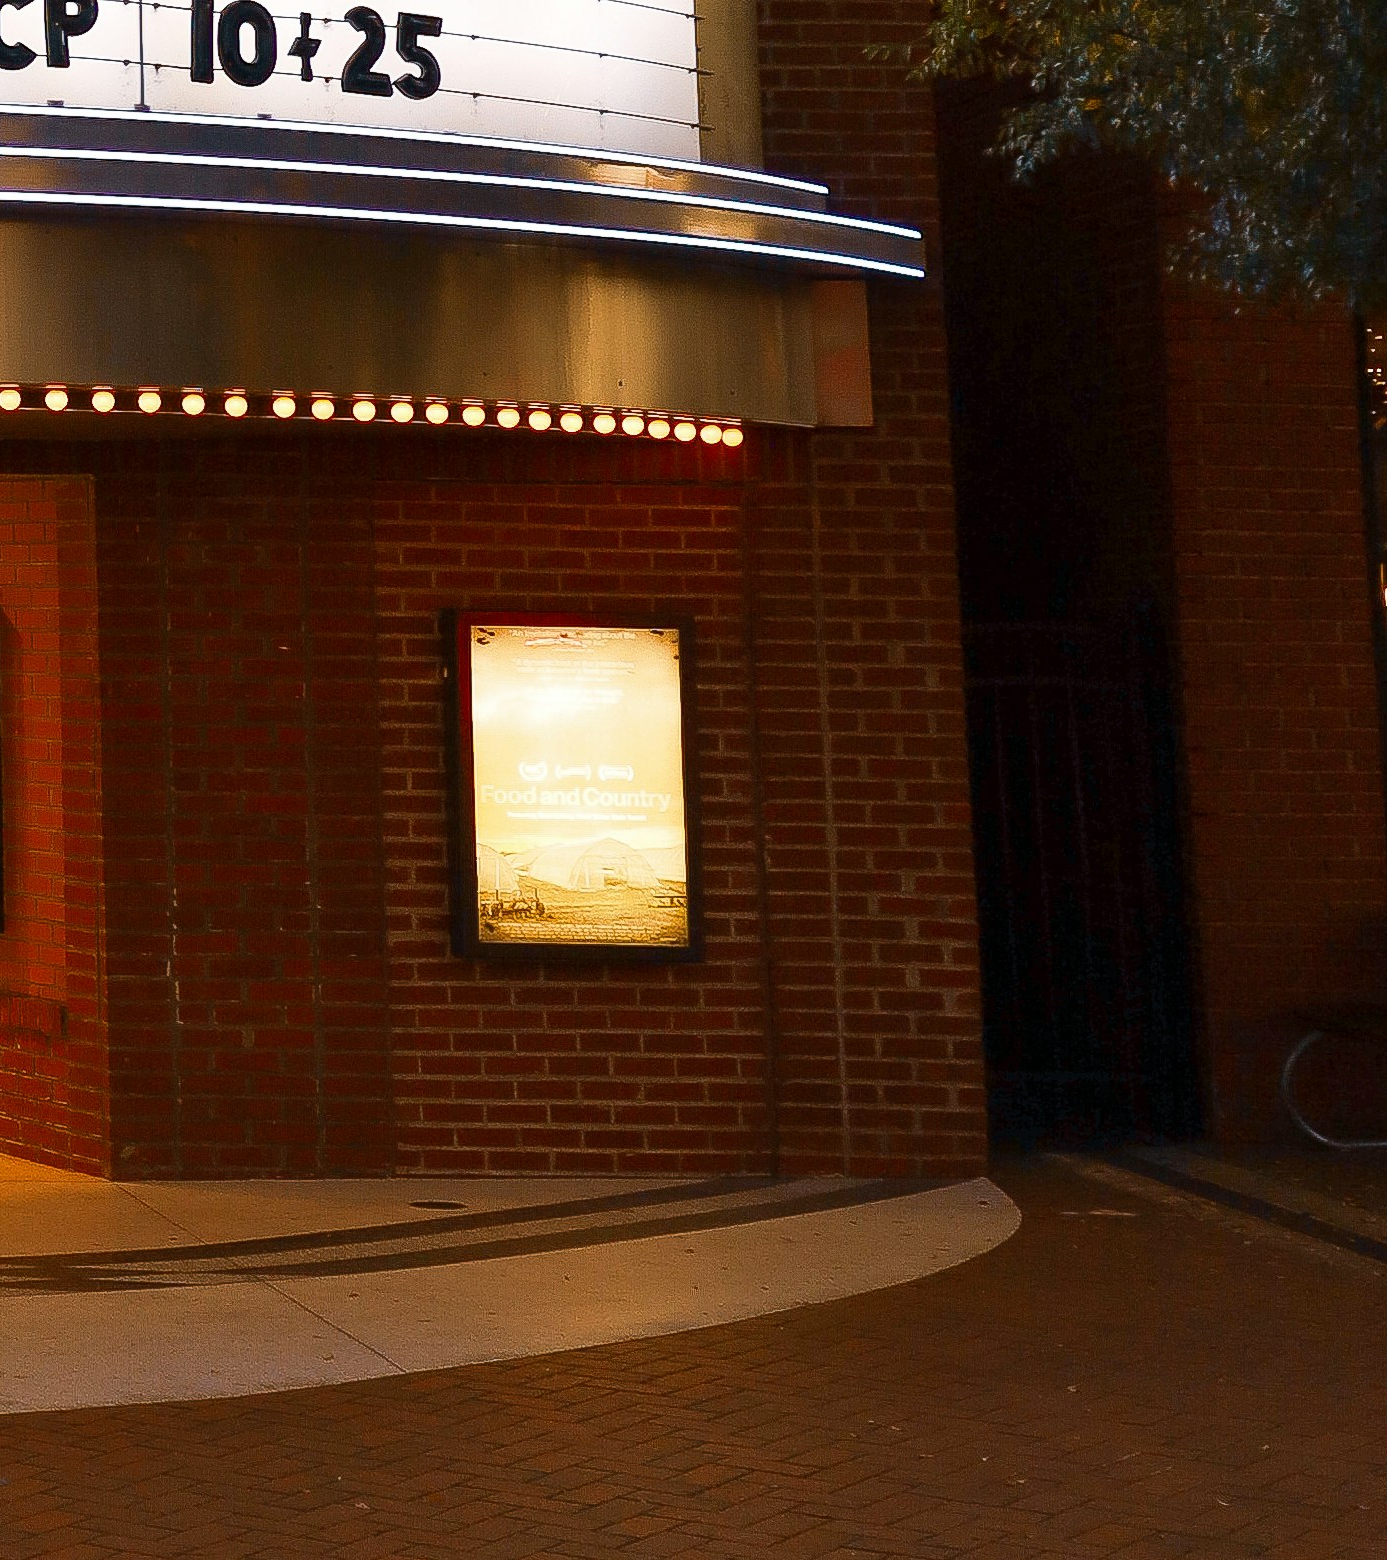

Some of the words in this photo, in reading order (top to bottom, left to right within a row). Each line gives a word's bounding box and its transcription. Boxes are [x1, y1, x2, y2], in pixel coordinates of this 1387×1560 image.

[481, 783, 537, 805] Food
[539, 785, 580, 806] and
[583, 787, 672, 812] Country
